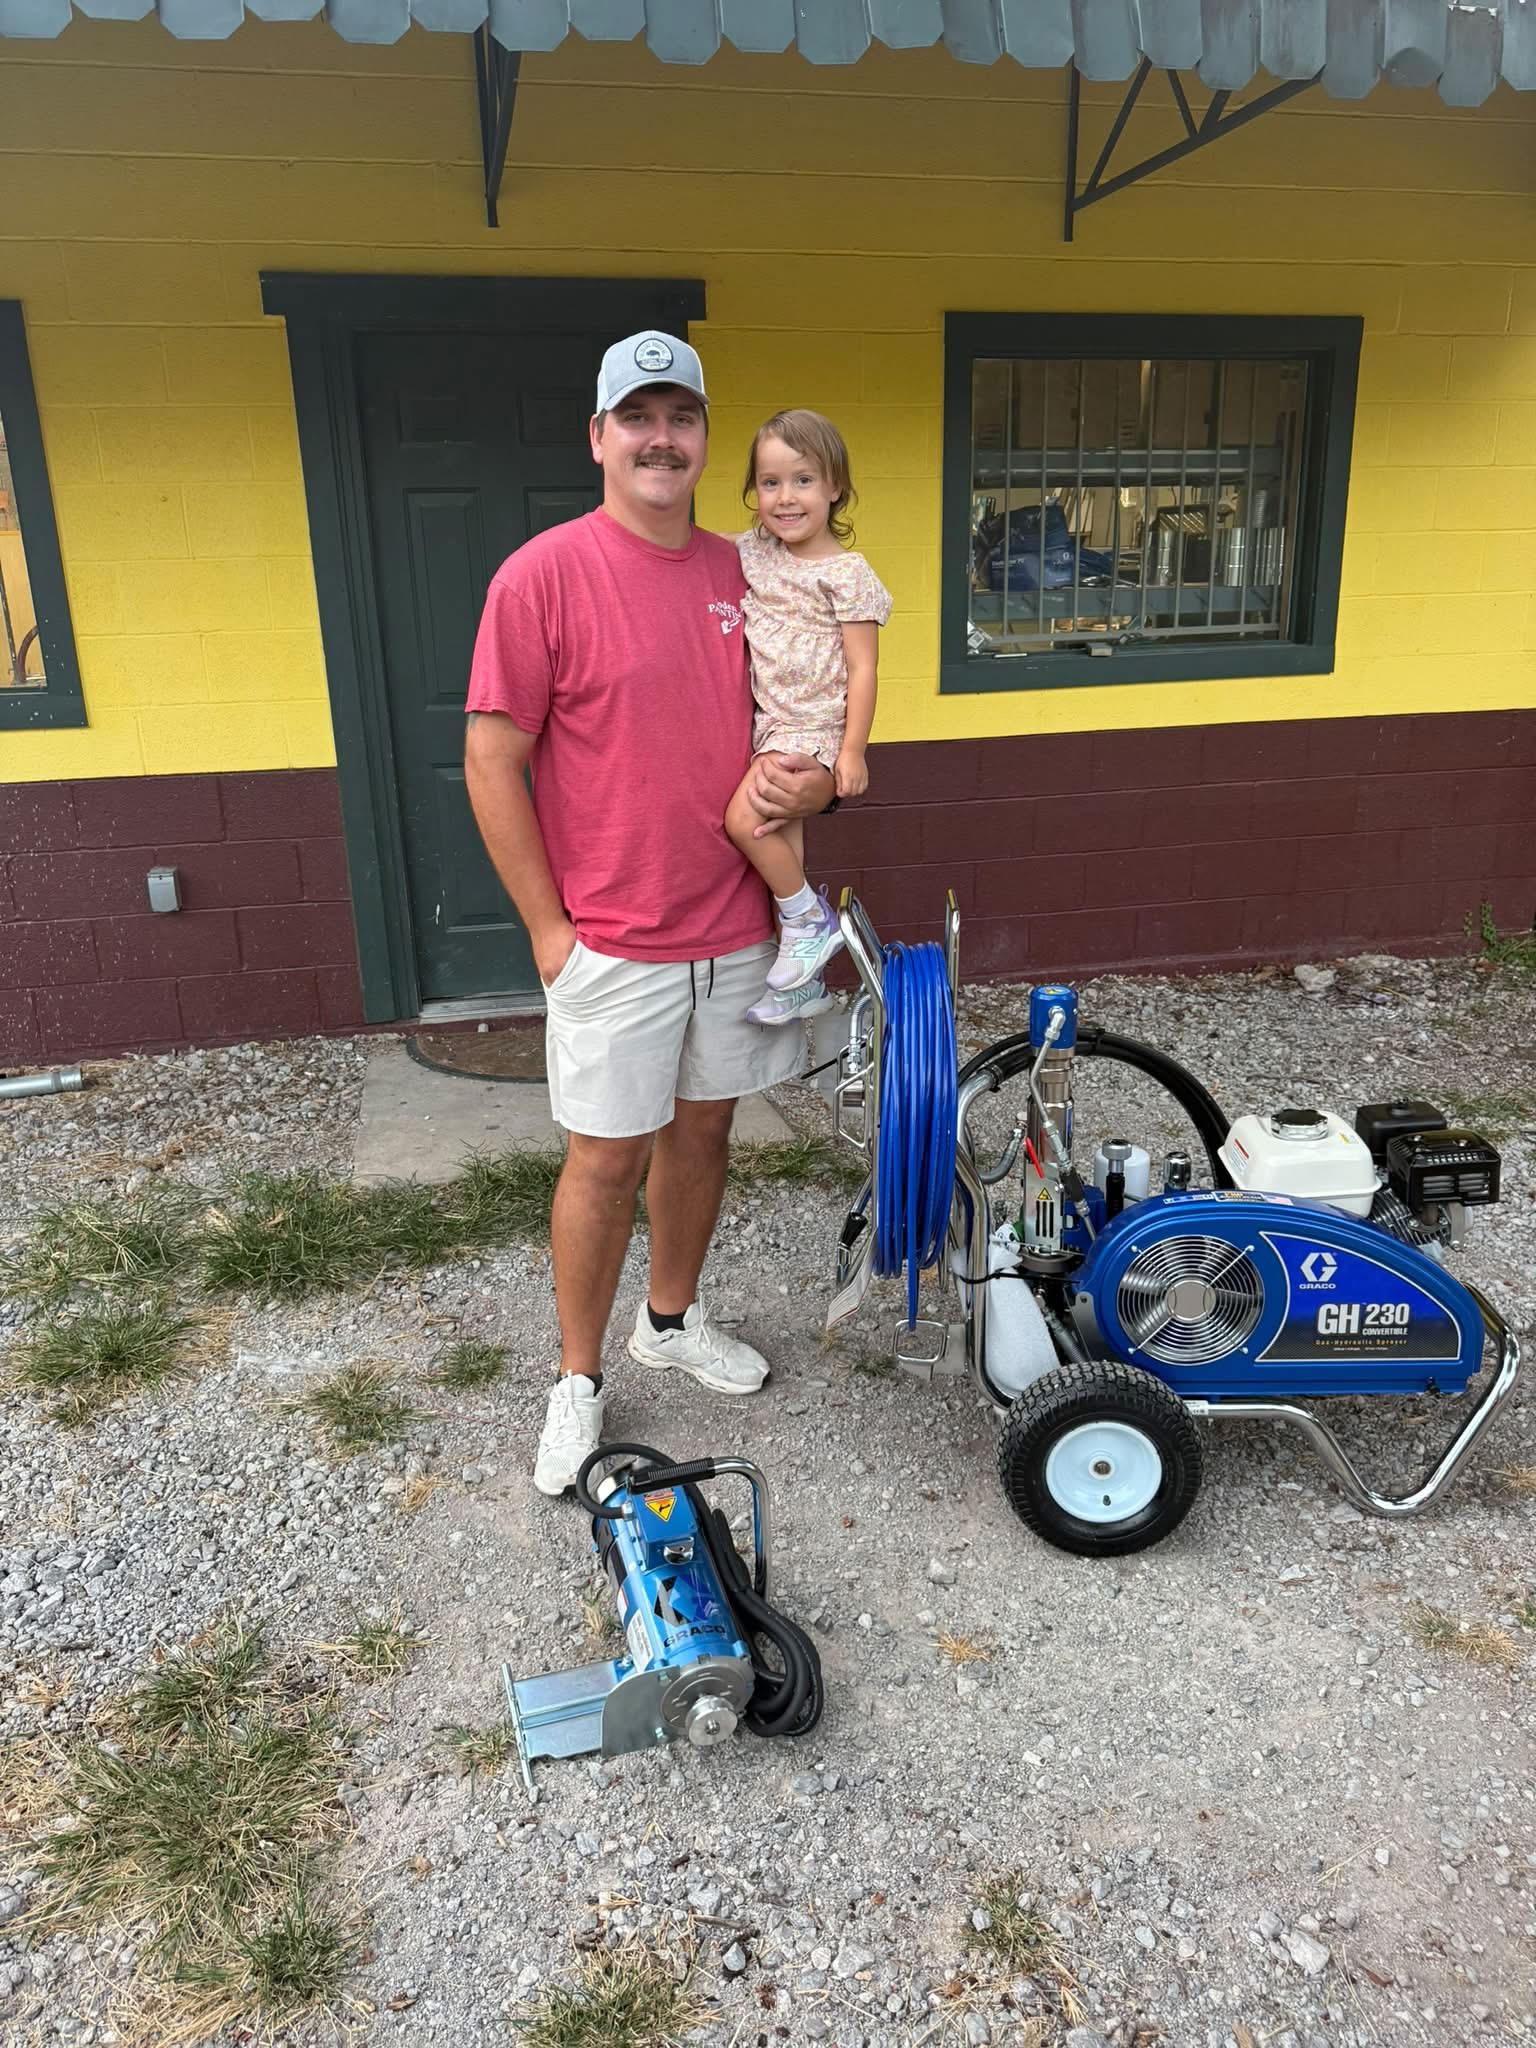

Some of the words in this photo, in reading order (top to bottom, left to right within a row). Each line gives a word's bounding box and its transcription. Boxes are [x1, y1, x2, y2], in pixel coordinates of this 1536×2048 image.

[1317, 1303, 1360, 1334] GH
[1365, 1303, 1410, 1325] 230
[1362, 1327, 1408, 1336] CONVERTIBLE
[664, 1625, 725, 1647] GRACO
